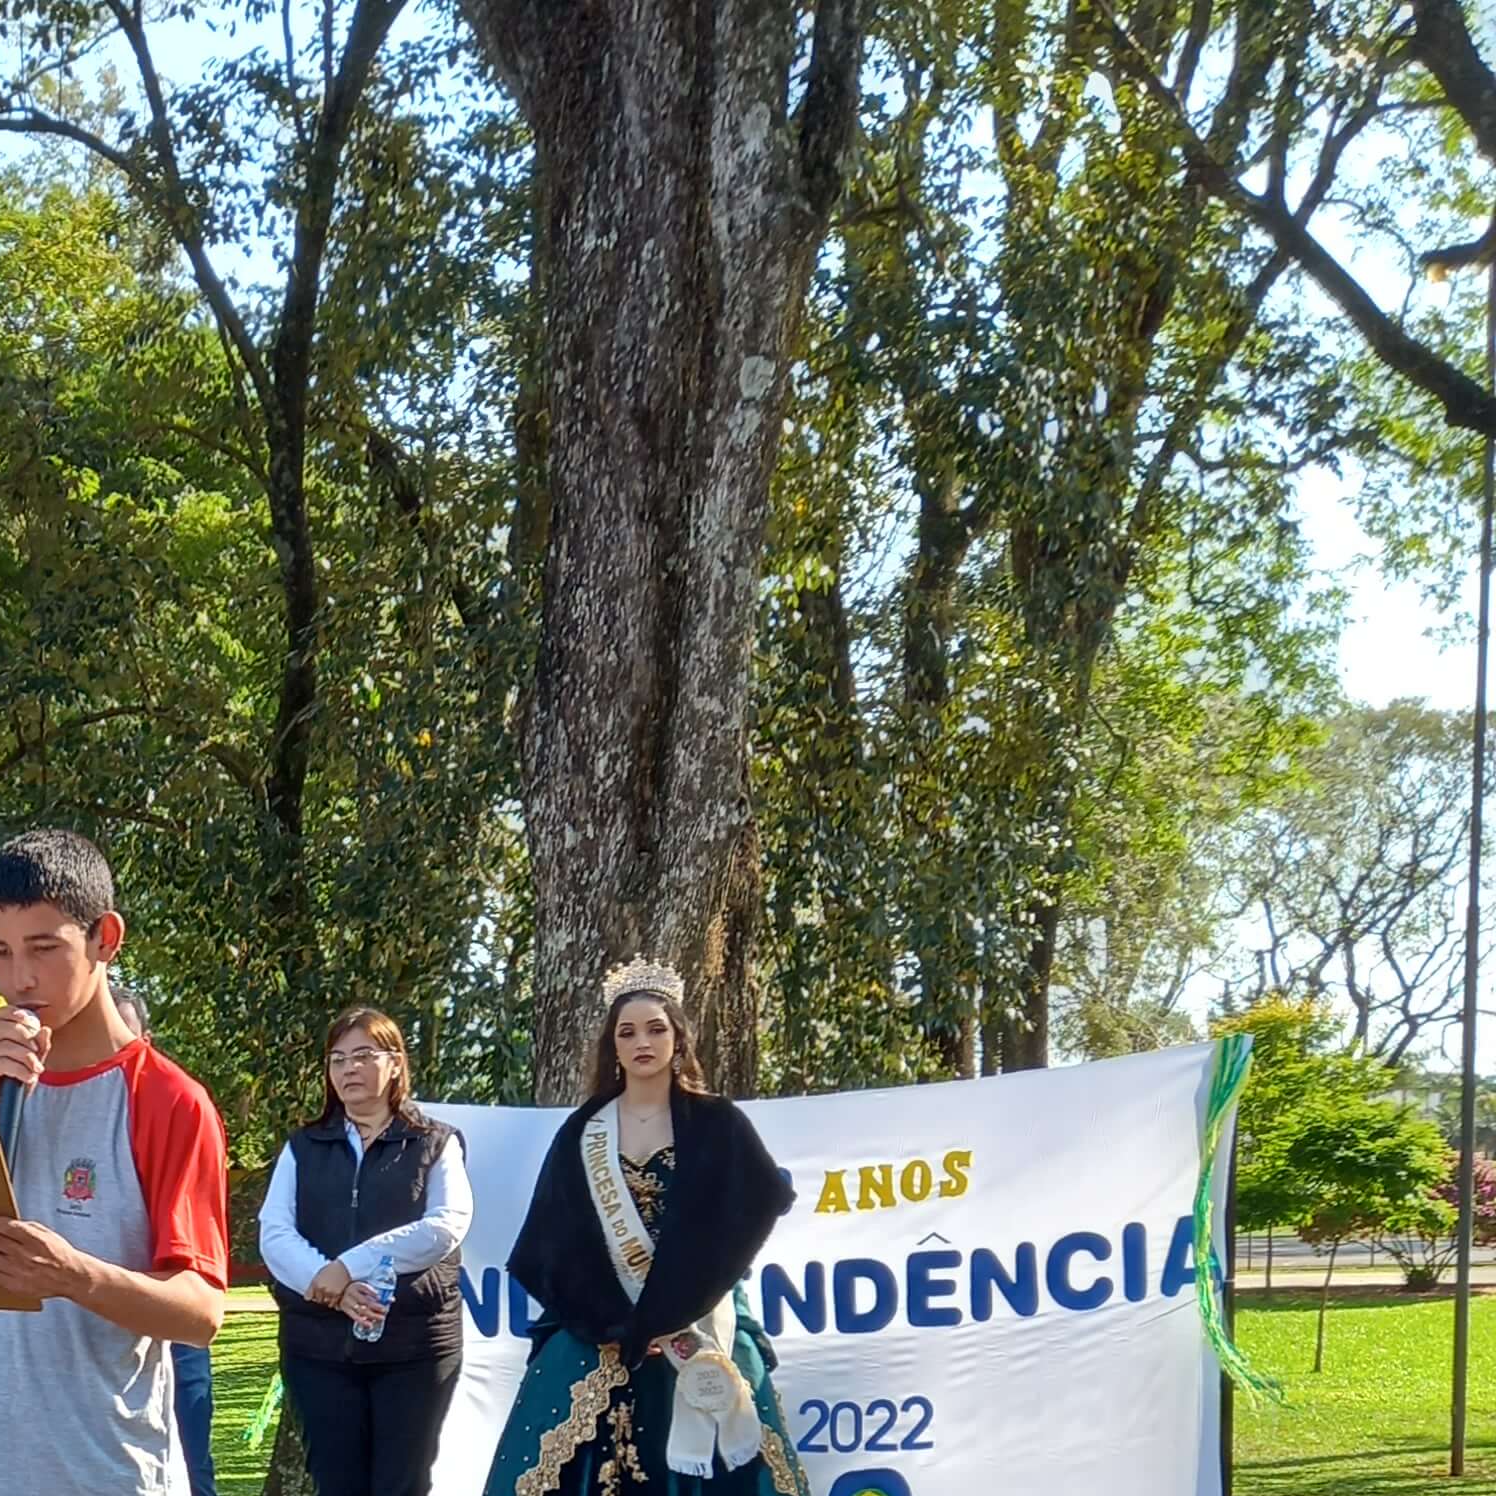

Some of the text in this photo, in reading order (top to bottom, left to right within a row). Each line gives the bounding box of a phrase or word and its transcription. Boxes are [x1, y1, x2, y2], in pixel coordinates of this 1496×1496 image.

[585, 1131, 623, 1219] PRINCESA
[611, 1218, 628, 1238] DO
[814, 1150, 973, 1214] ANOS
[796, 1395, 935, 1454] 2022
